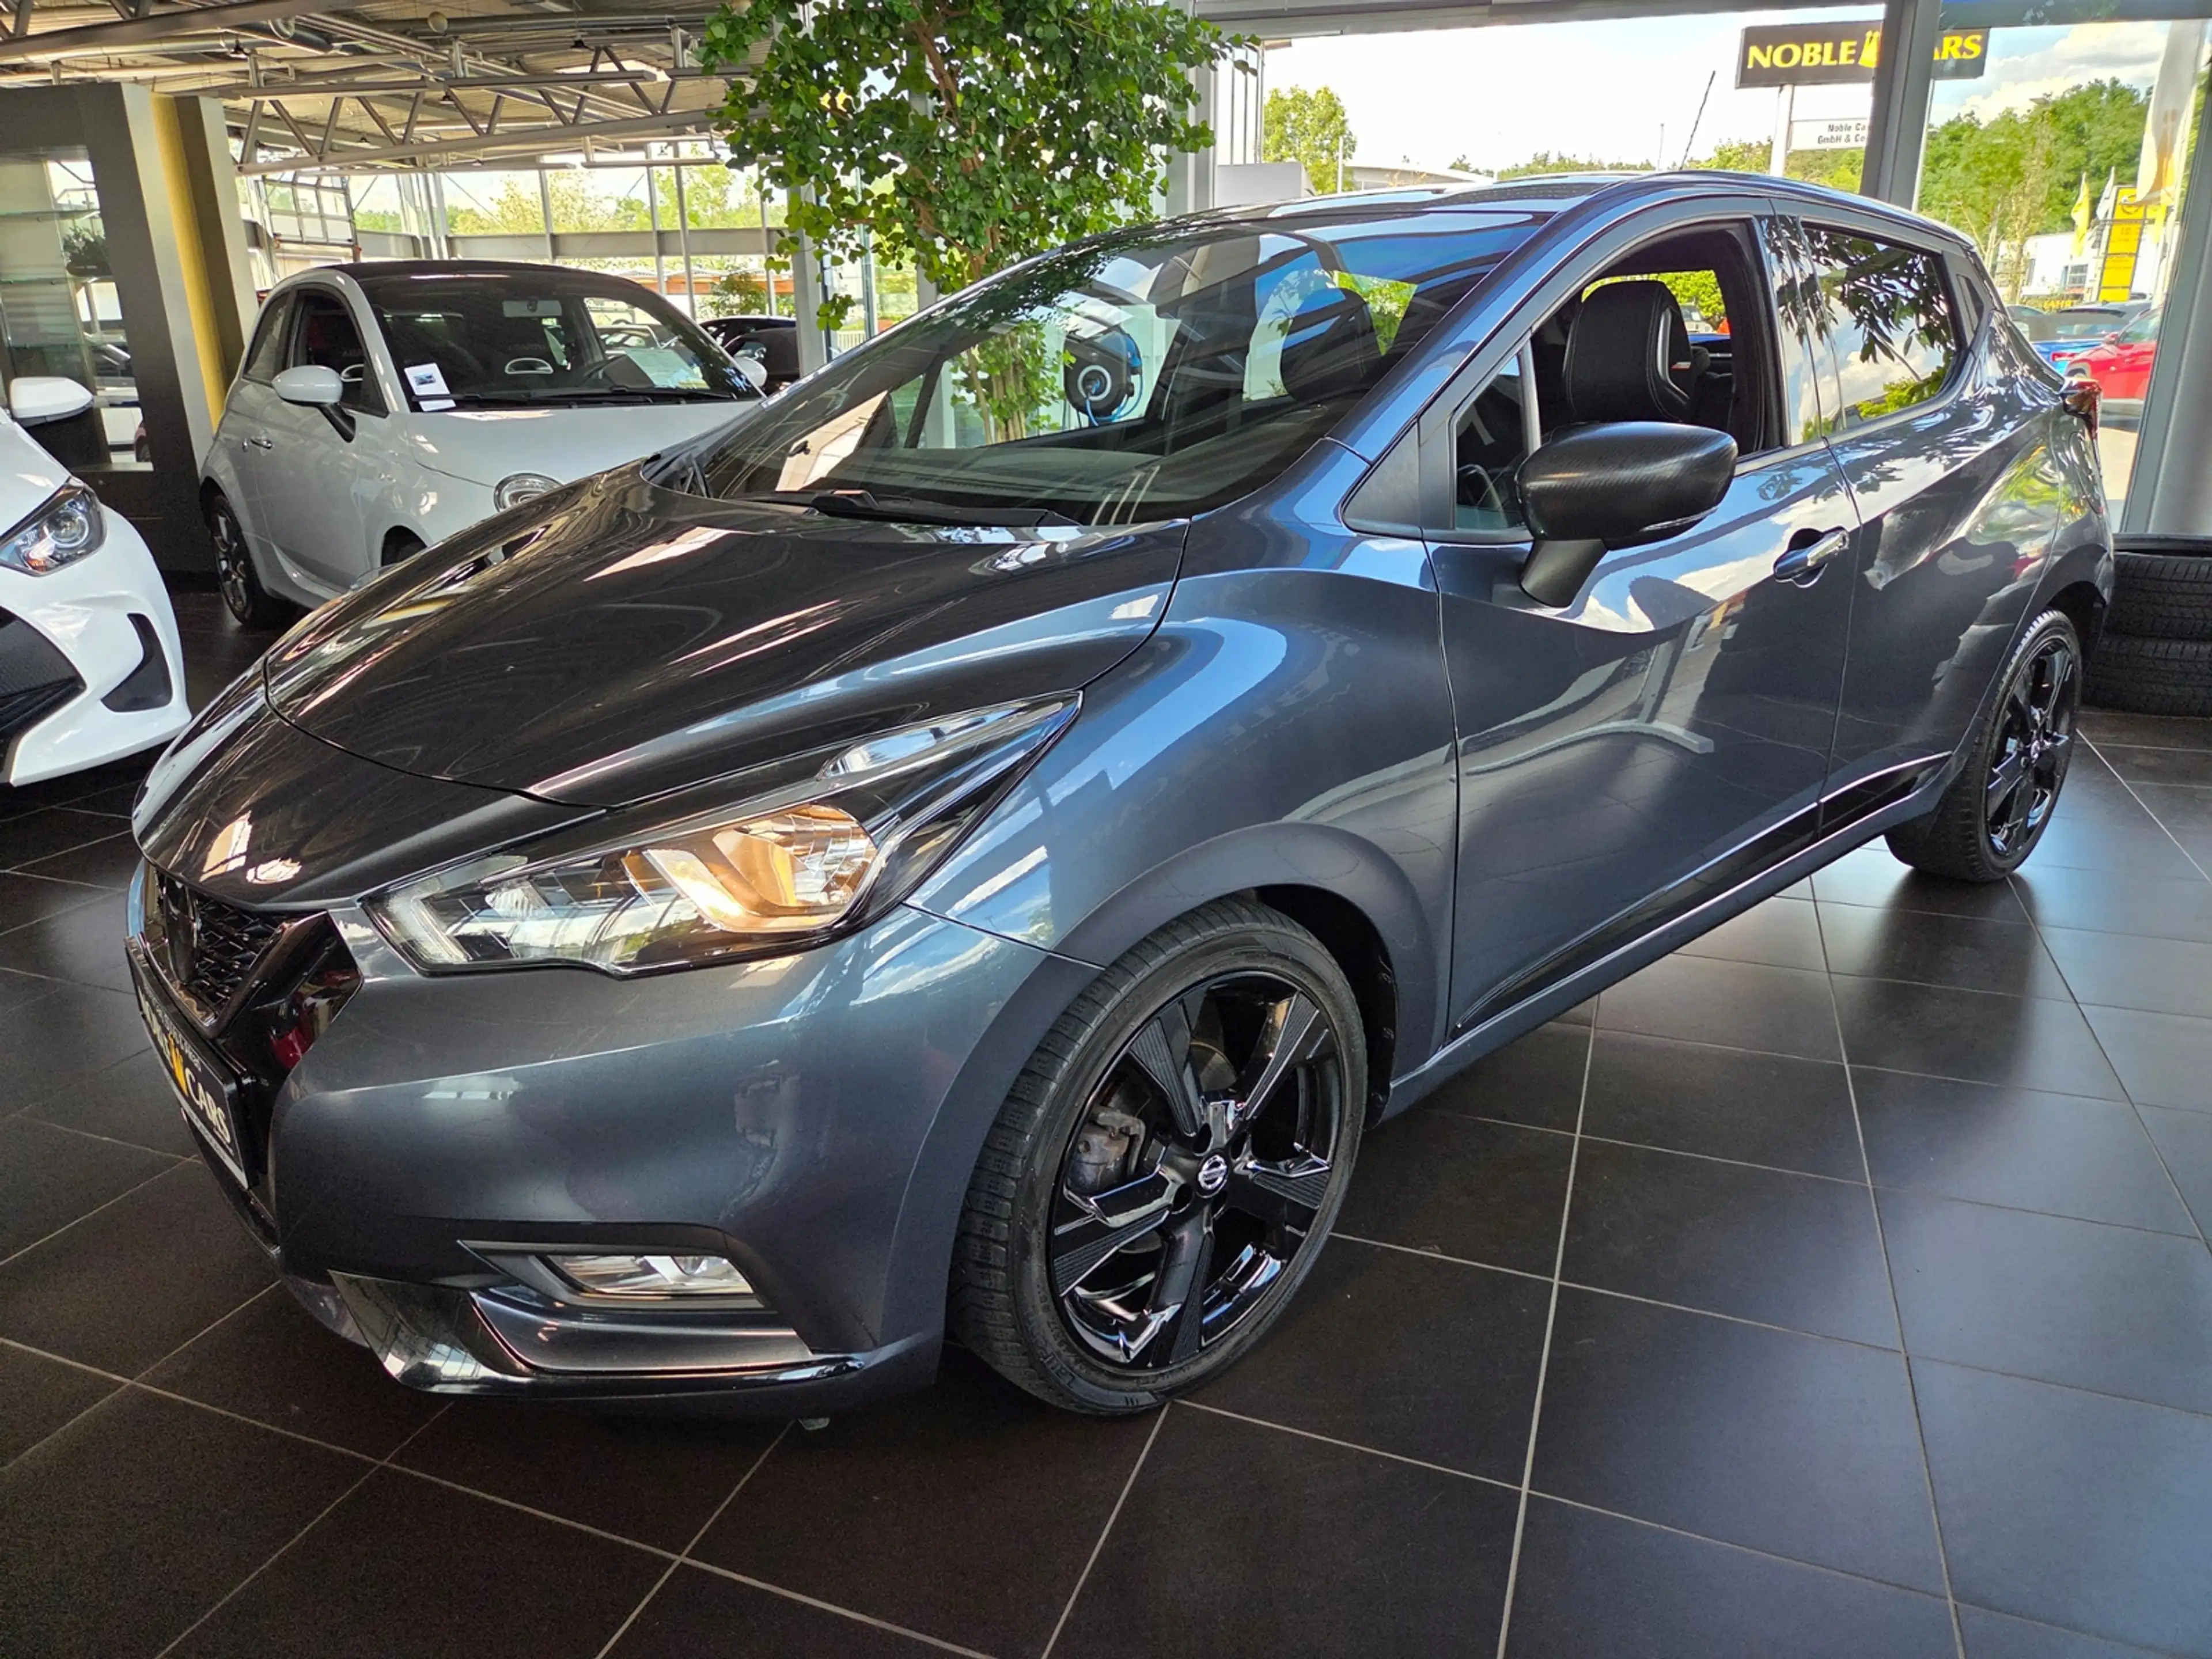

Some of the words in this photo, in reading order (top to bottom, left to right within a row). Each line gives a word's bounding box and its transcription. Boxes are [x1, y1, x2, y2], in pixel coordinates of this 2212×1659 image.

[1747, 40, 1858, 69] NOBLE
[1933, 34, 1982, 60] RS
[1827, 123, 1852, 132] Noble
[1855, 123, 1868, 131] Ca
[1817, 135, 1842, 145] GmbH
[1844, 134, 1851, 143] &
[184, 1067, 230, 1145] CARS
